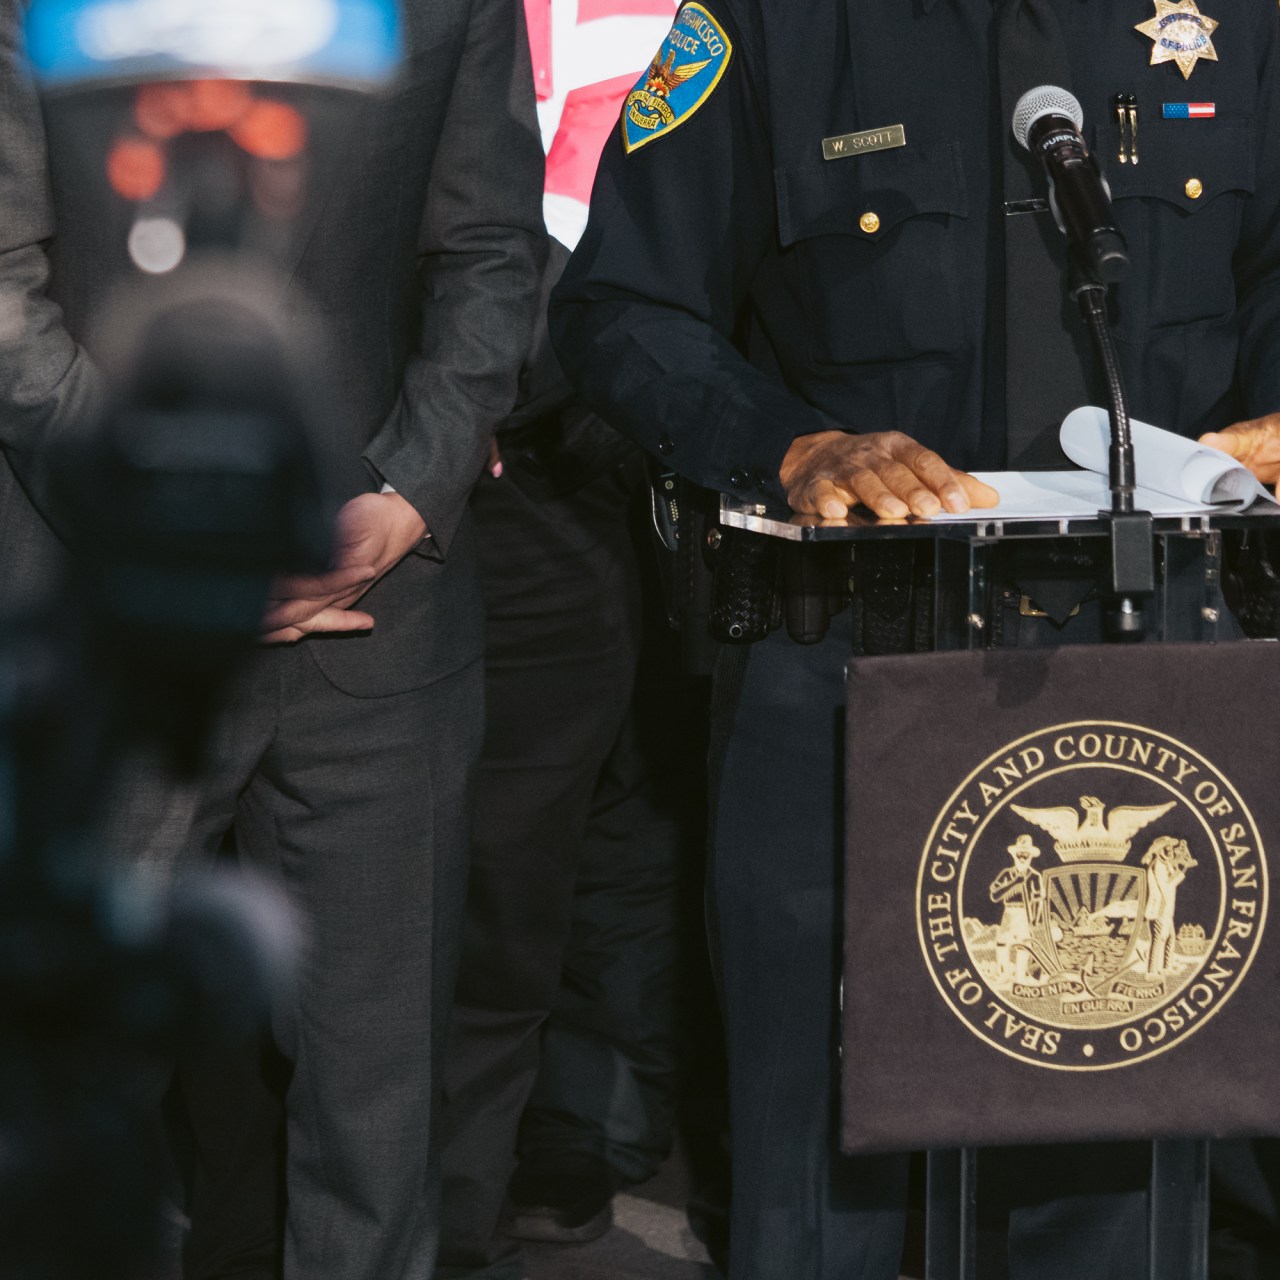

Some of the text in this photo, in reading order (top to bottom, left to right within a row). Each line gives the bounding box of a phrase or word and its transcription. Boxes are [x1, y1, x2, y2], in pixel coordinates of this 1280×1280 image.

[832, 131, 892, 153] W. SCOTT
[927, 733, 1258, 1055] SEAL OF THE CITY AND COUNTY OF SAN FRANCISCO
